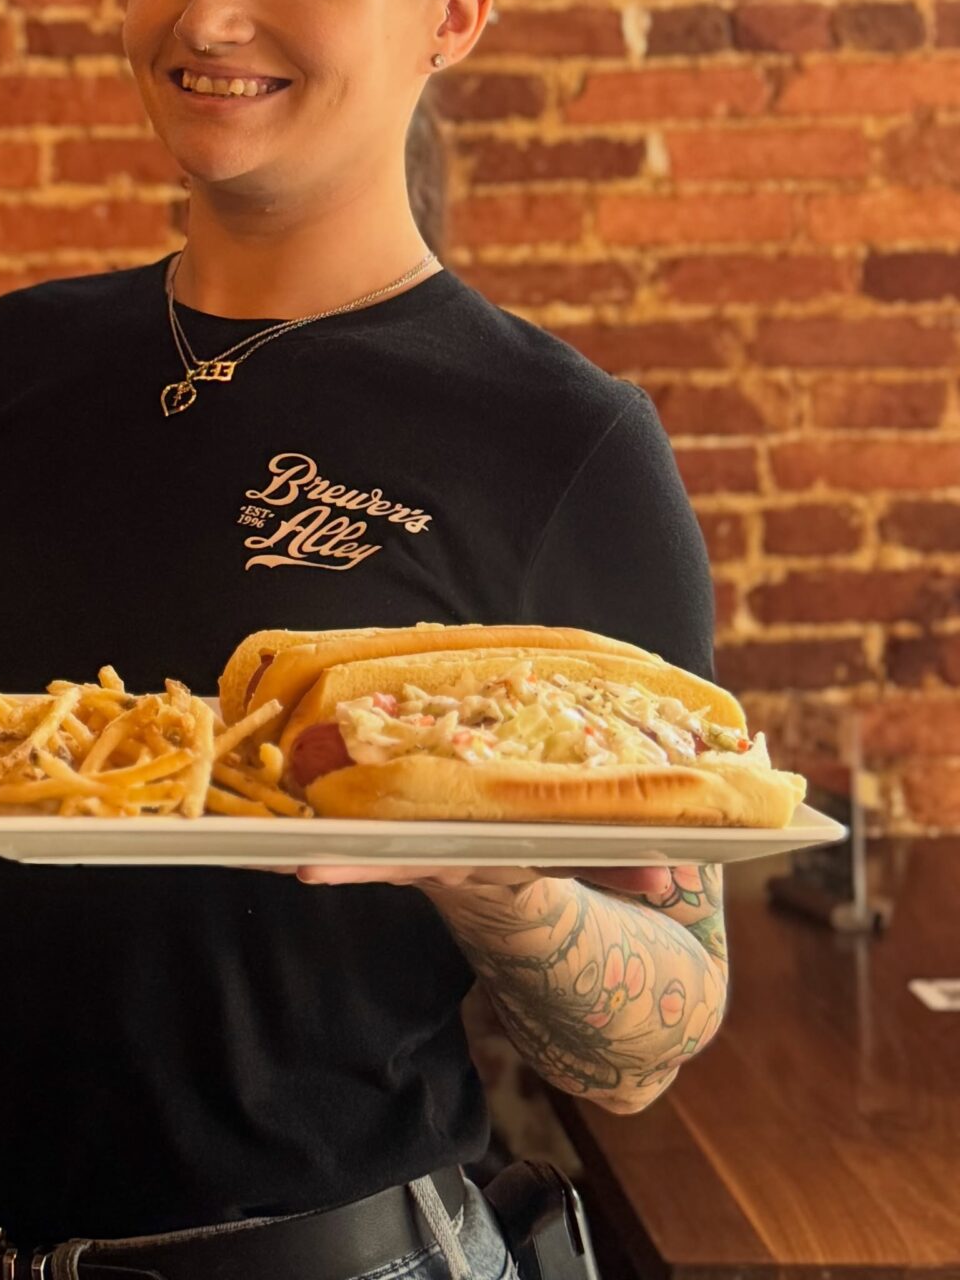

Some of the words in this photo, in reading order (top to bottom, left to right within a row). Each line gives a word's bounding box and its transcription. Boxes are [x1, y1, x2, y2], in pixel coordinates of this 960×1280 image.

[243, 505, 272, 519] EST
[245, 452, 433, 534] Brewer's
[236, 514, 267, 529] 1996
[243, 505, 383, 571] Alley
